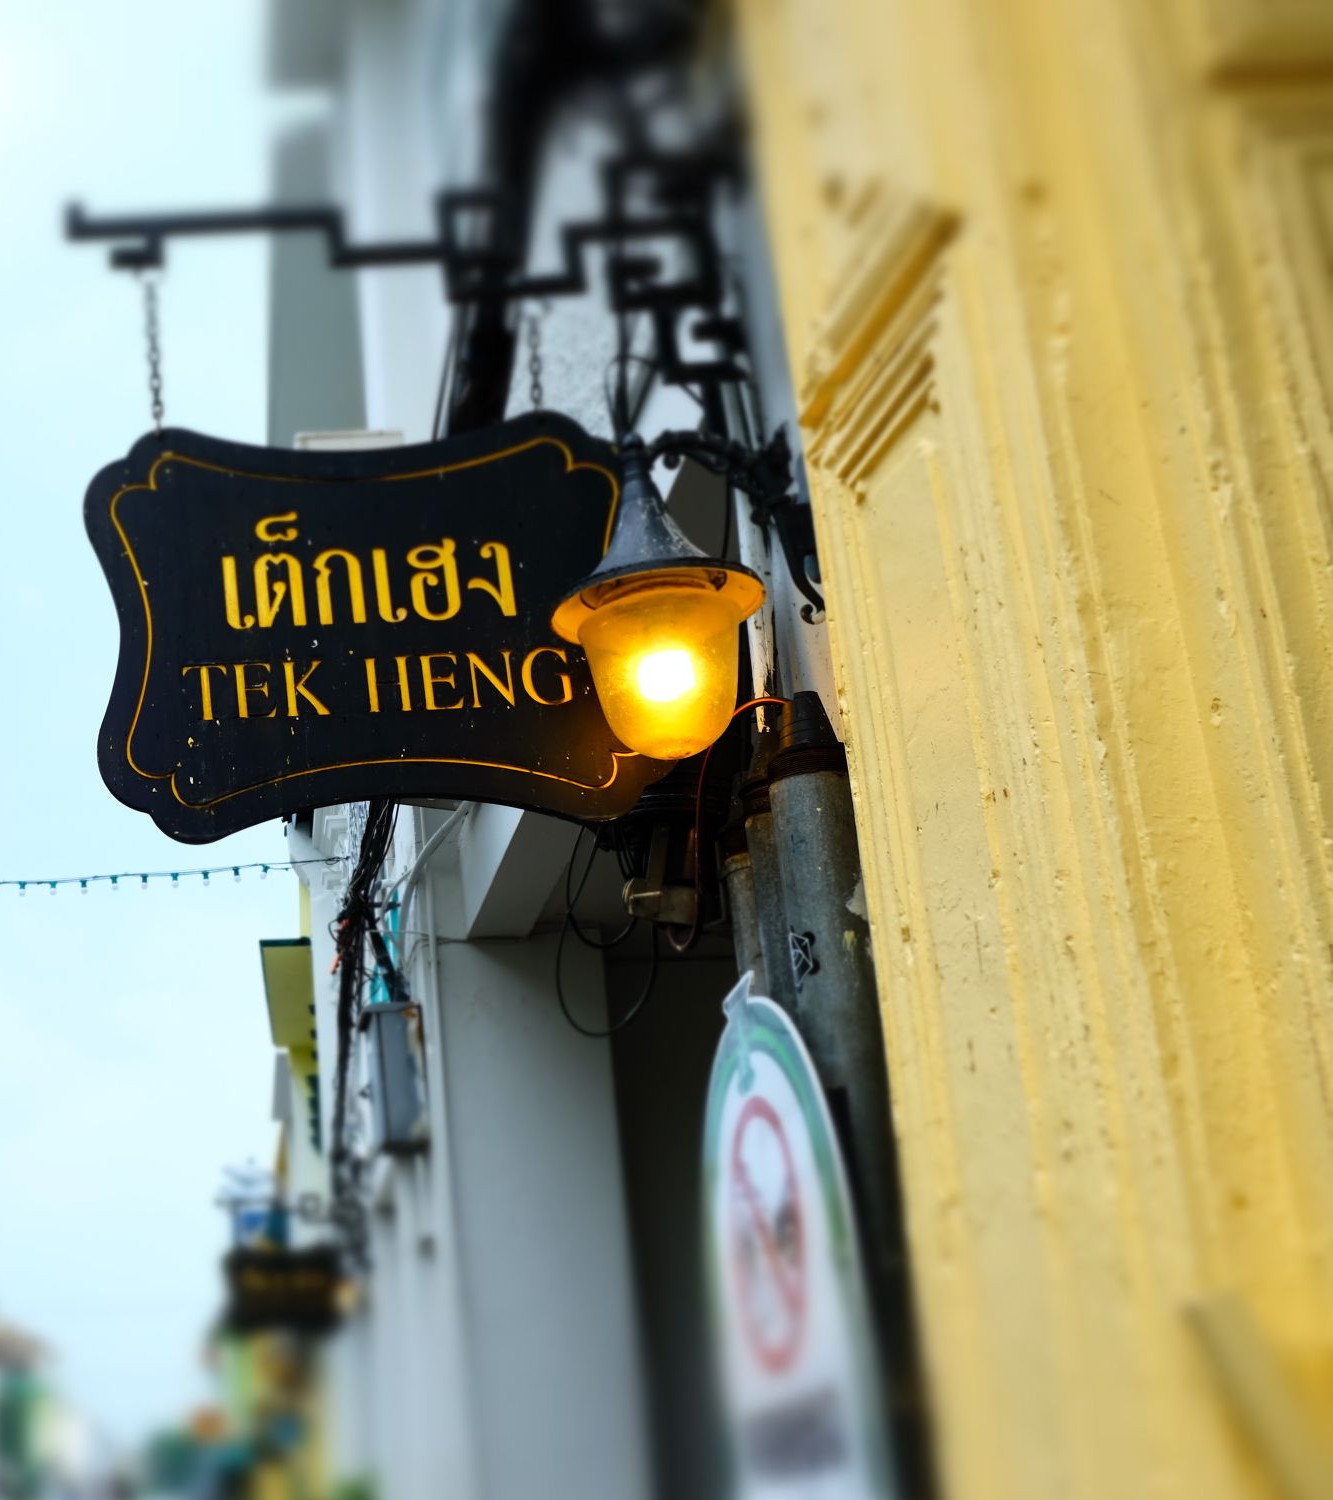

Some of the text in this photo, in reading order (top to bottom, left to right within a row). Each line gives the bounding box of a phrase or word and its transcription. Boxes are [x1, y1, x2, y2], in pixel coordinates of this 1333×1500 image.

[221, 512, 517, 629] เต็กเฮง
[182, 648, 574, 722] TEK HENG
